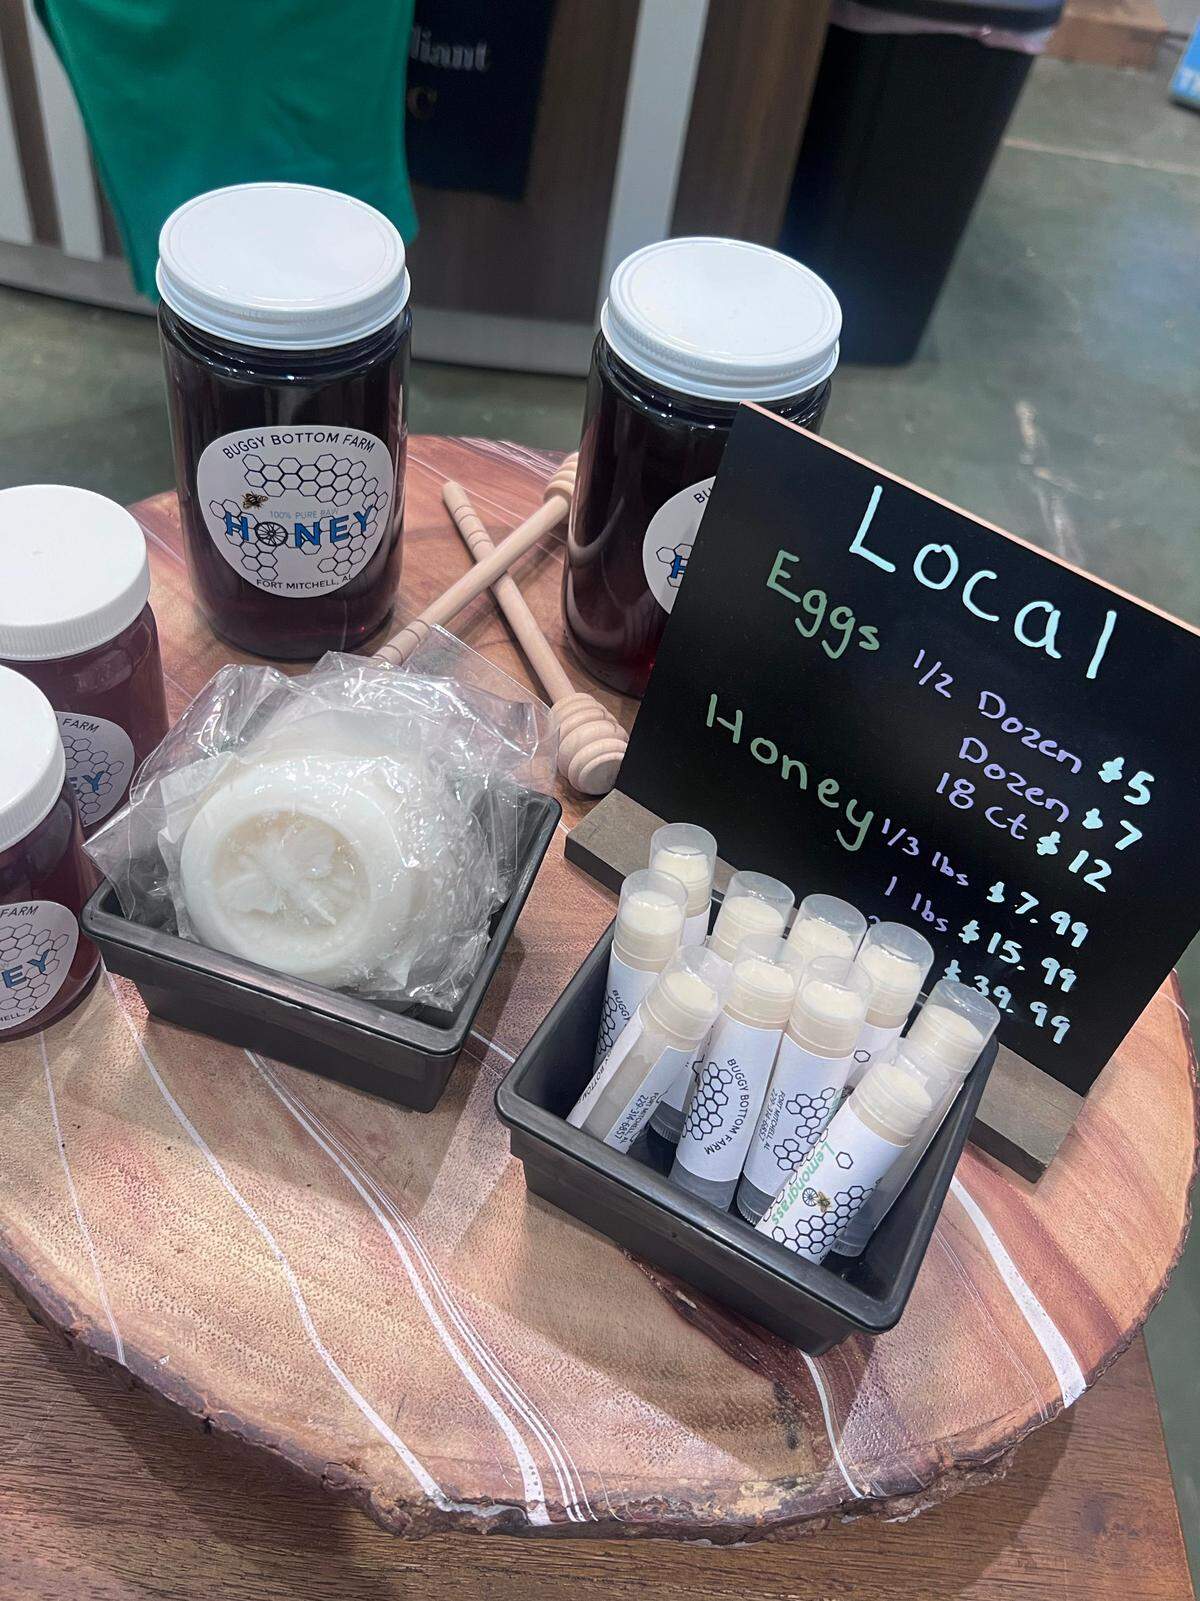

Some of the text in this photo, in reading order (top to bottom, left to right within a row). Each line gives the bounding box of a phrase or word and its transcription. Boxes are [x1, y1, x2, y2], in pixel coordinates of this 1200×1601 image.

[222, 432, 376, 459] BUGGY BOTTOM FARM
[270, 510, 292, 520] 100%
[295, 510, 318, 521] PURE
[256, 579, 283, 589] FORT
[286, 578, 339, 590] MITCHELL,
[849, 485, 1117, 679] Local
[766, 549, 880, 659] Eggs
[62, 718, 100, 734] FARM
[913, 649, 952, 698] 1/2
[978, 690, 1082, 774] Dozen
[706, 693, 874, 852] Honey
[881, 818, 920, 856] 1/3
[932, 851, 969, 887] lbs
[936, 772, 975, 810] 18
[958, 737, 1070, 823] Dozen
[0, 905, 39, 918] FARM
[911, 892, 949, 932] lbs
[29, 1005, 40, 1013] AL
[703, 1057, 750, 1156] BUGGY BOTTOM FARM
[772, 1141, 836, 1226] Lemongrass
